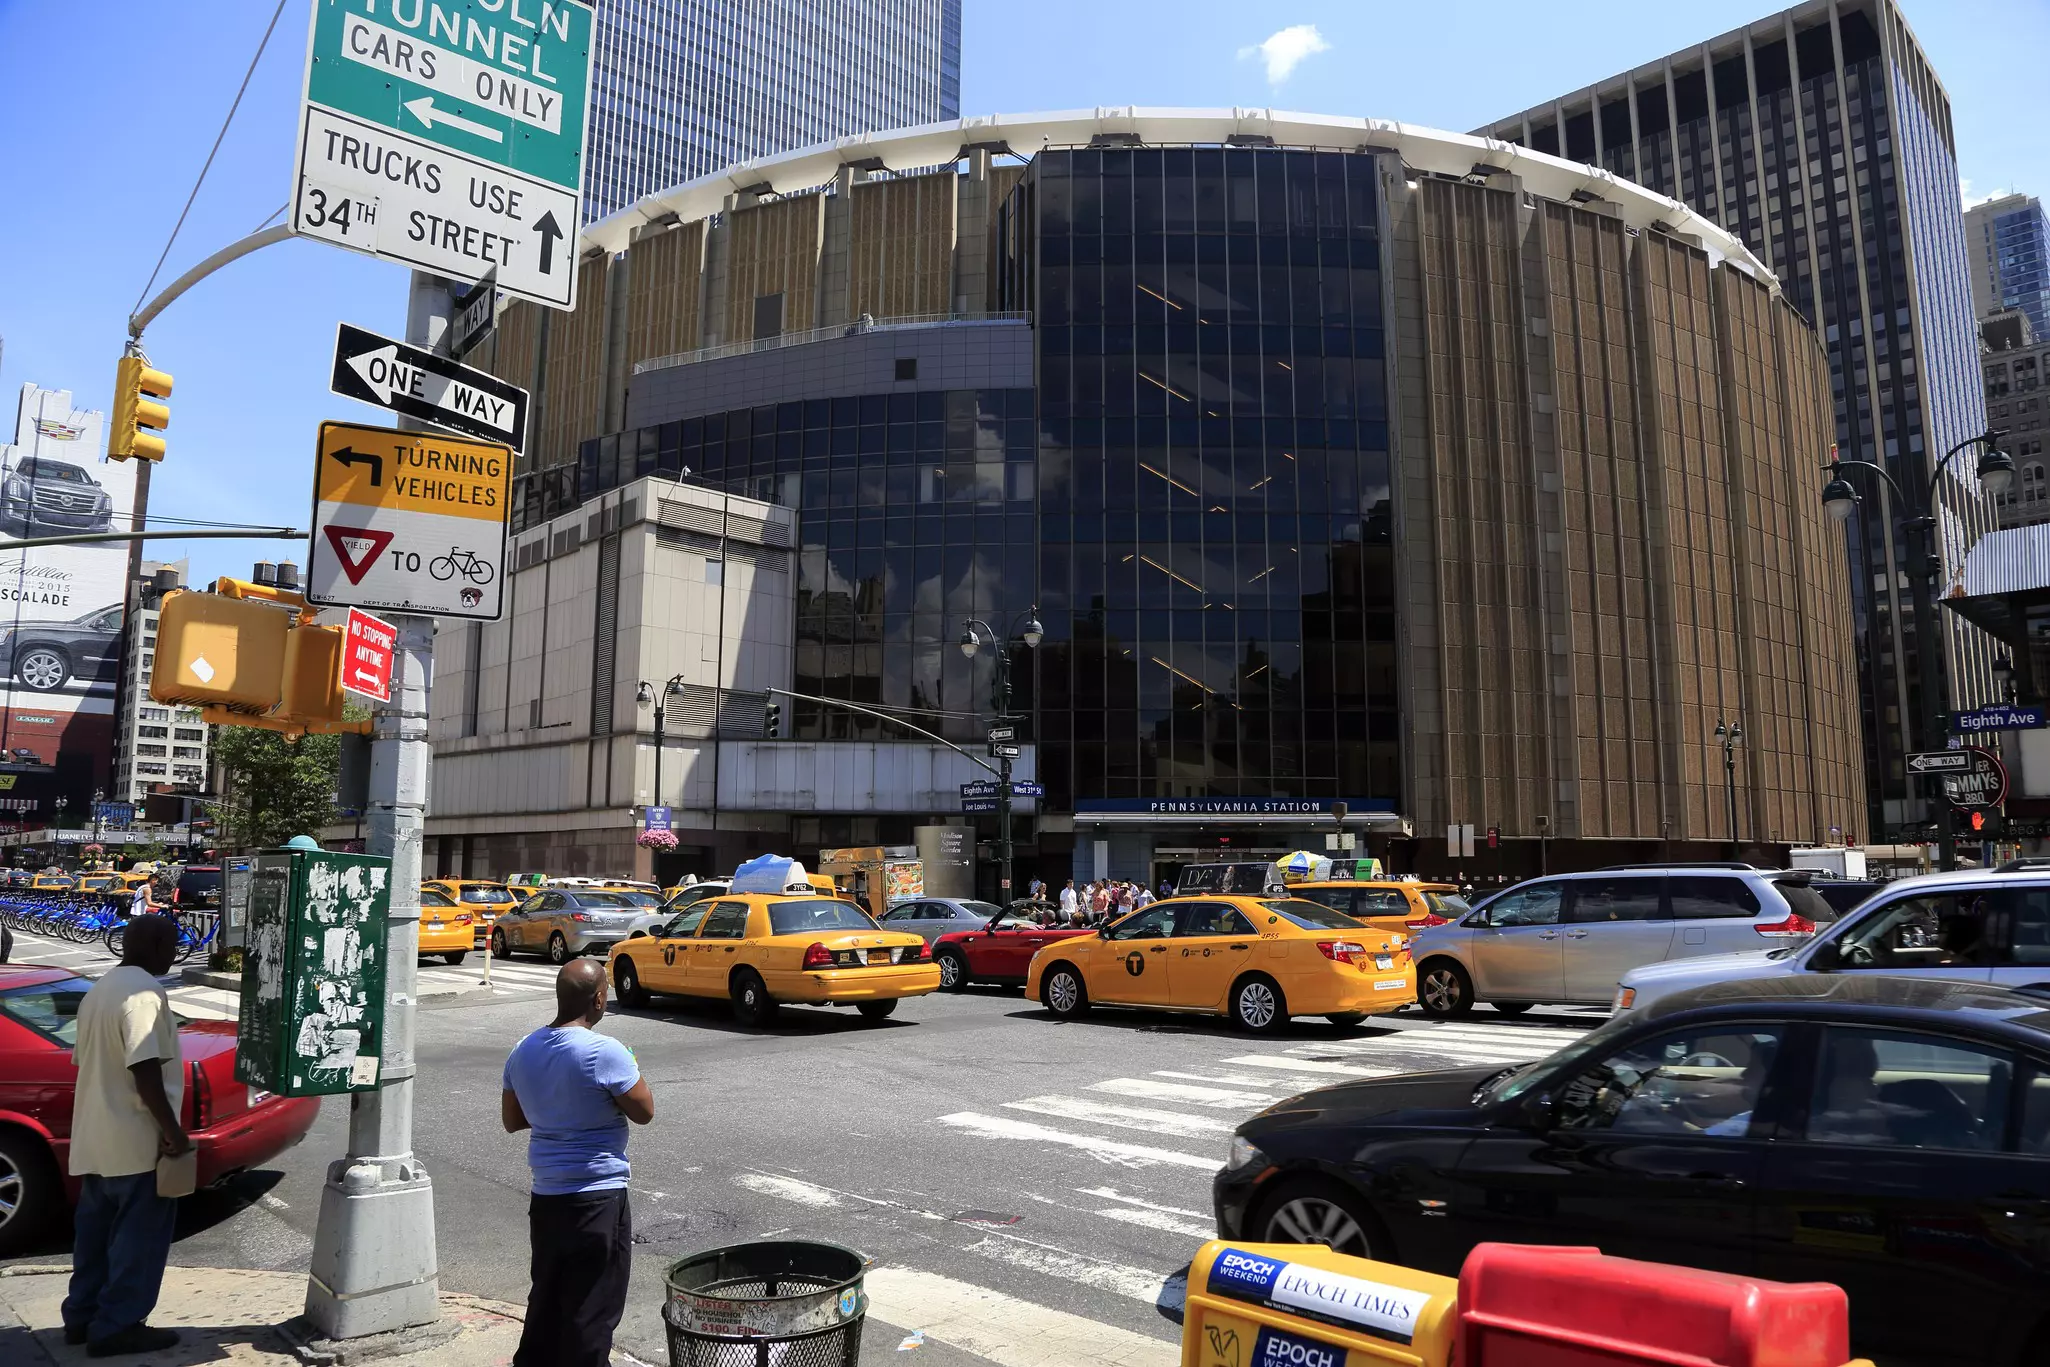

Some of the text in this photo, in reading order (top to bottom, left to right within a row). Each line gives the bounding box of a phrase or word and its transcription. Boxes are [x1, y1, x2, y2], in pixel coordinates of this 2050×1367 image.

[351, 24, 554, 122] CARS ONLY
[324, 128, 523, 221] TRUCKS USE
[305, 188, 514, 267] 34TH STREET
[464, 295, 487, 338] WAY
[369, 357, 506, 424] ONE WAY
[394, 445, 500, 477] TURNING
[394, 476, 496, 507] VEHICLES
[344, 540, 371, 551] YIELD
[391, 550, 420, 572] TO
[0, 588, 70, 607] SCALADE
[38, 581, 71, 593] 2015
[393, 602, 450, 612] TRANSPORTATION
[351, 620, 392, 650] NO STOPPING
[356, 644, 383, 668] ANYTIME
[1960, 712, 2036, 730] Eighth Ave
[1916, 756, 1960, 767] ONE WAY
[963, 785, 995, 796] Eighth Ave
[1014, 785, 1027, 794] West
[1958, 771, 1999, 792] MMY'S
[965, 803, 973, 811] Joe
[1151, 802, 1320, 812] PENNSYLVANIA STATION
[1219, 1266, 1268, 1285] WEEKEND
[1222, 1254, 1276, 1276] EPOCH
[1283, 1274, 1347, 1304] EPOCH
[1351, 1291, 1411, 1320] TIMES
[702, 1309, 745, 1319] HOUSEHOL
[707, 1316, 744, 1325] BUSINES
[1266, 1336, 1333, 1367] EPOCH
